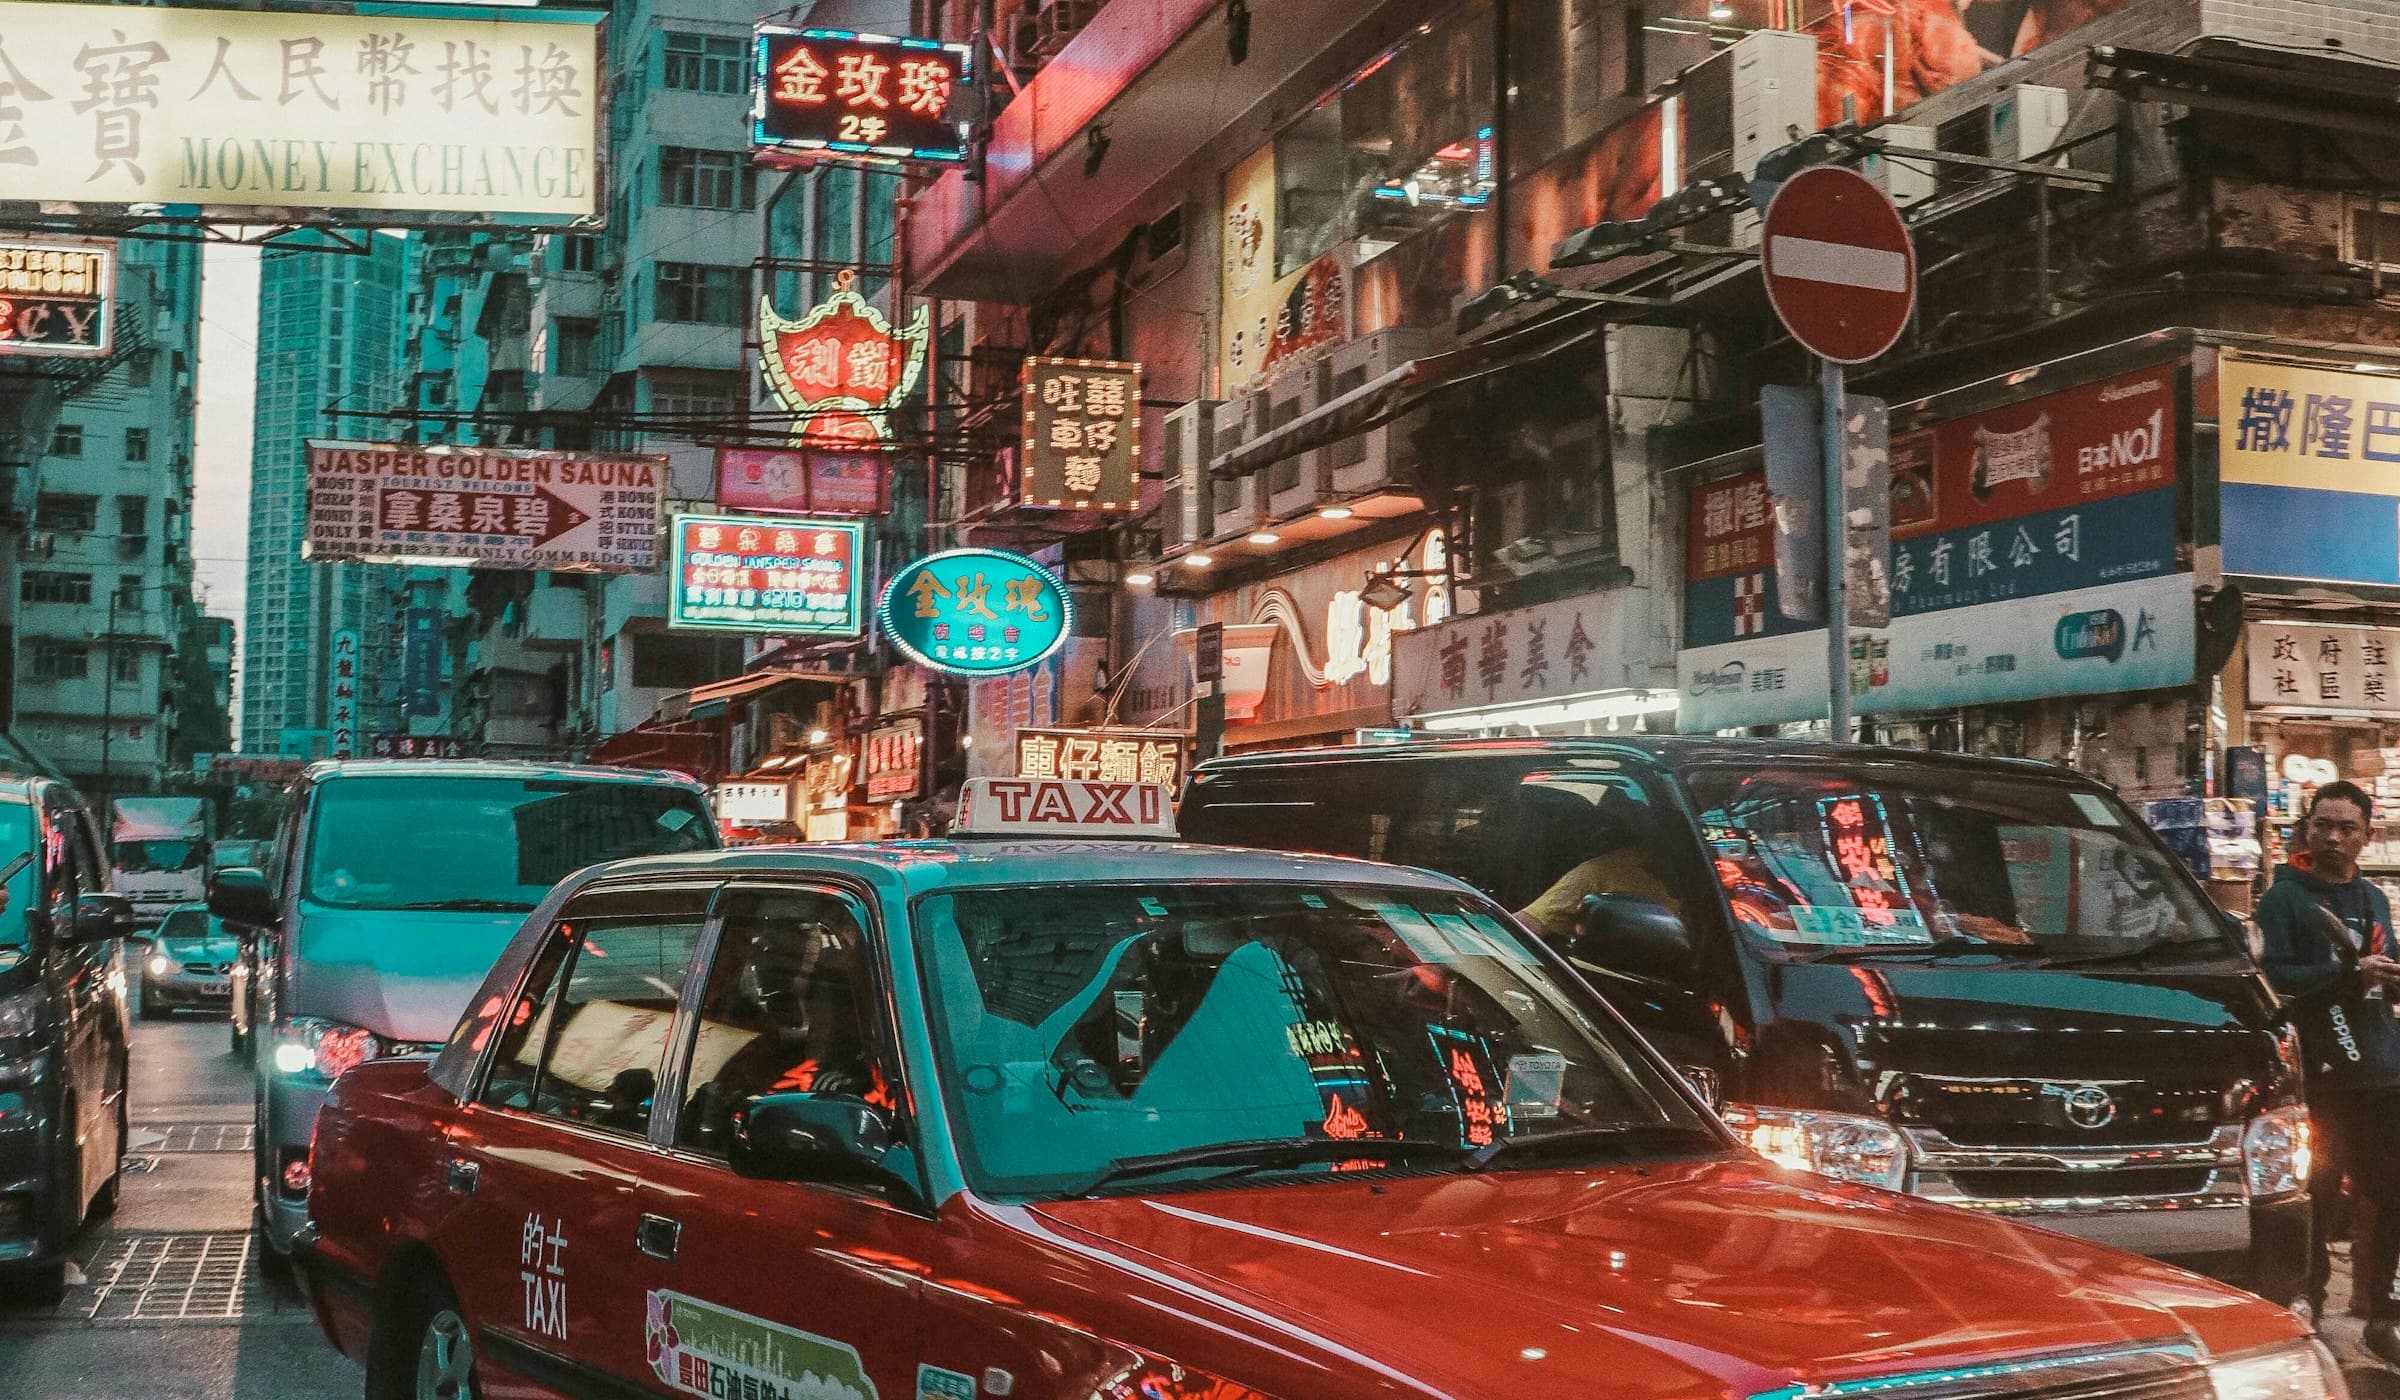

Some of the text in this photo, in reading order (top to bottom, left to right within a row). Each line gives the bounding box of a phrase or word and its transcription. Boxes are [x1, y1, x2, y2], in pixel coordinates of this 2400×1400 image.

[186, 32, 583, 118] 人民幣找換
[179, 136, 587, 200] MONEY EXCHANGE
[318, 450, 654, 487] JASPER GOLDEN SAUNA
[314, 525, 352, 539] ONLY
[1703, 480, 1775, 537] 撒隆
[906, 570, 1048, 622] 金玫瑰
[2272, 634, 2387, 666] 政府註
[2272, 668, 2386, 702] 社區藥
[1019, 736, 1177, 797] 車仔麵飯
[989, 781, 1160, 824] TAXI
[2329, 1004, 2361, 1061] adidas
[521, 1212, 568, 1275] 的士
[521, 1271, 567, 1340] TAXI
